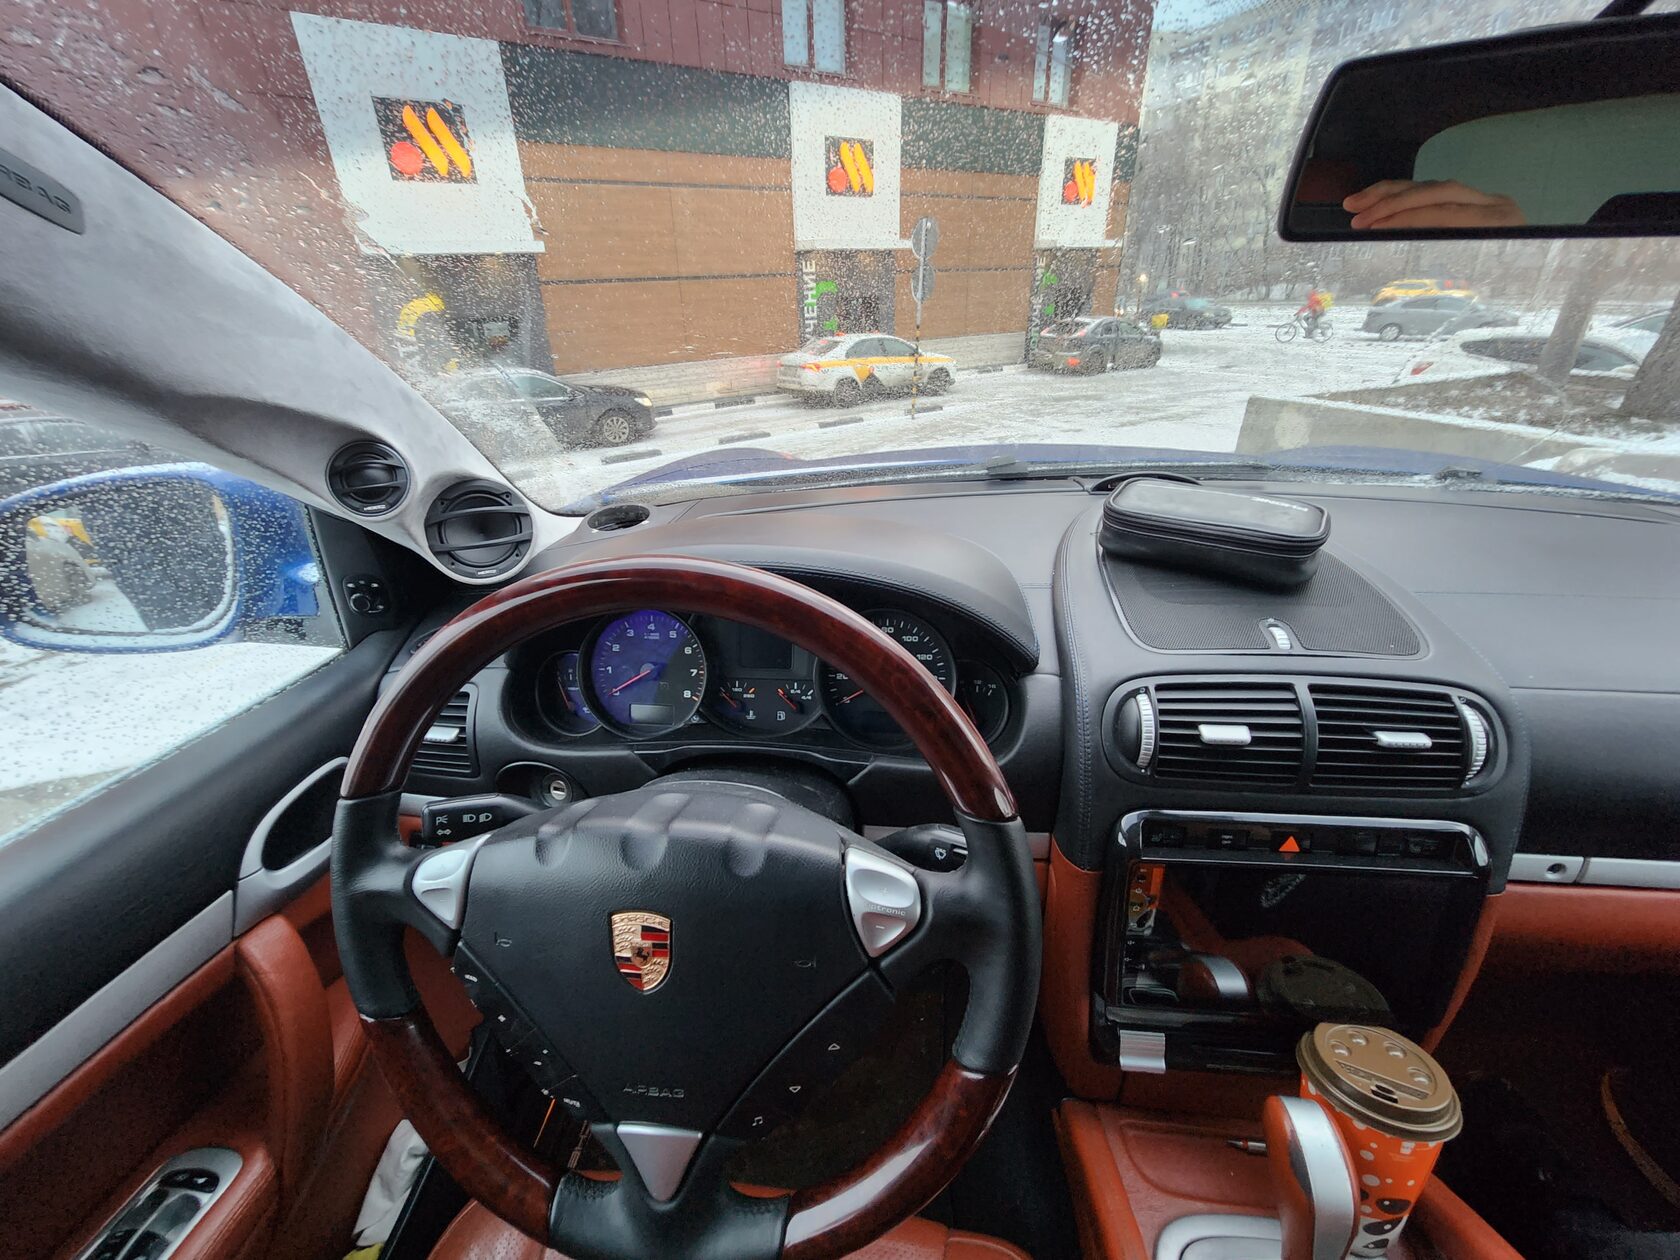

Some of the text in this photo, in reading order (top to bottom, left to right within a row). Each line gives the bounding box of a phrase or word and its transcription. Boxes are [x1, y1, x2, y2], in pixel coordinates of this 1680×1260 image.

[647, 623, 656, 631] 4
[626, 629, 635, 637] 3
[669, 630, 677, 638] 5
[612, 644, 620, 652] 2
[684, 646, 692, 655] 6
[606, 666, 613, 674] 1
[690, 669, 698, 677] 7
[683, 690, 692, 698] 8
